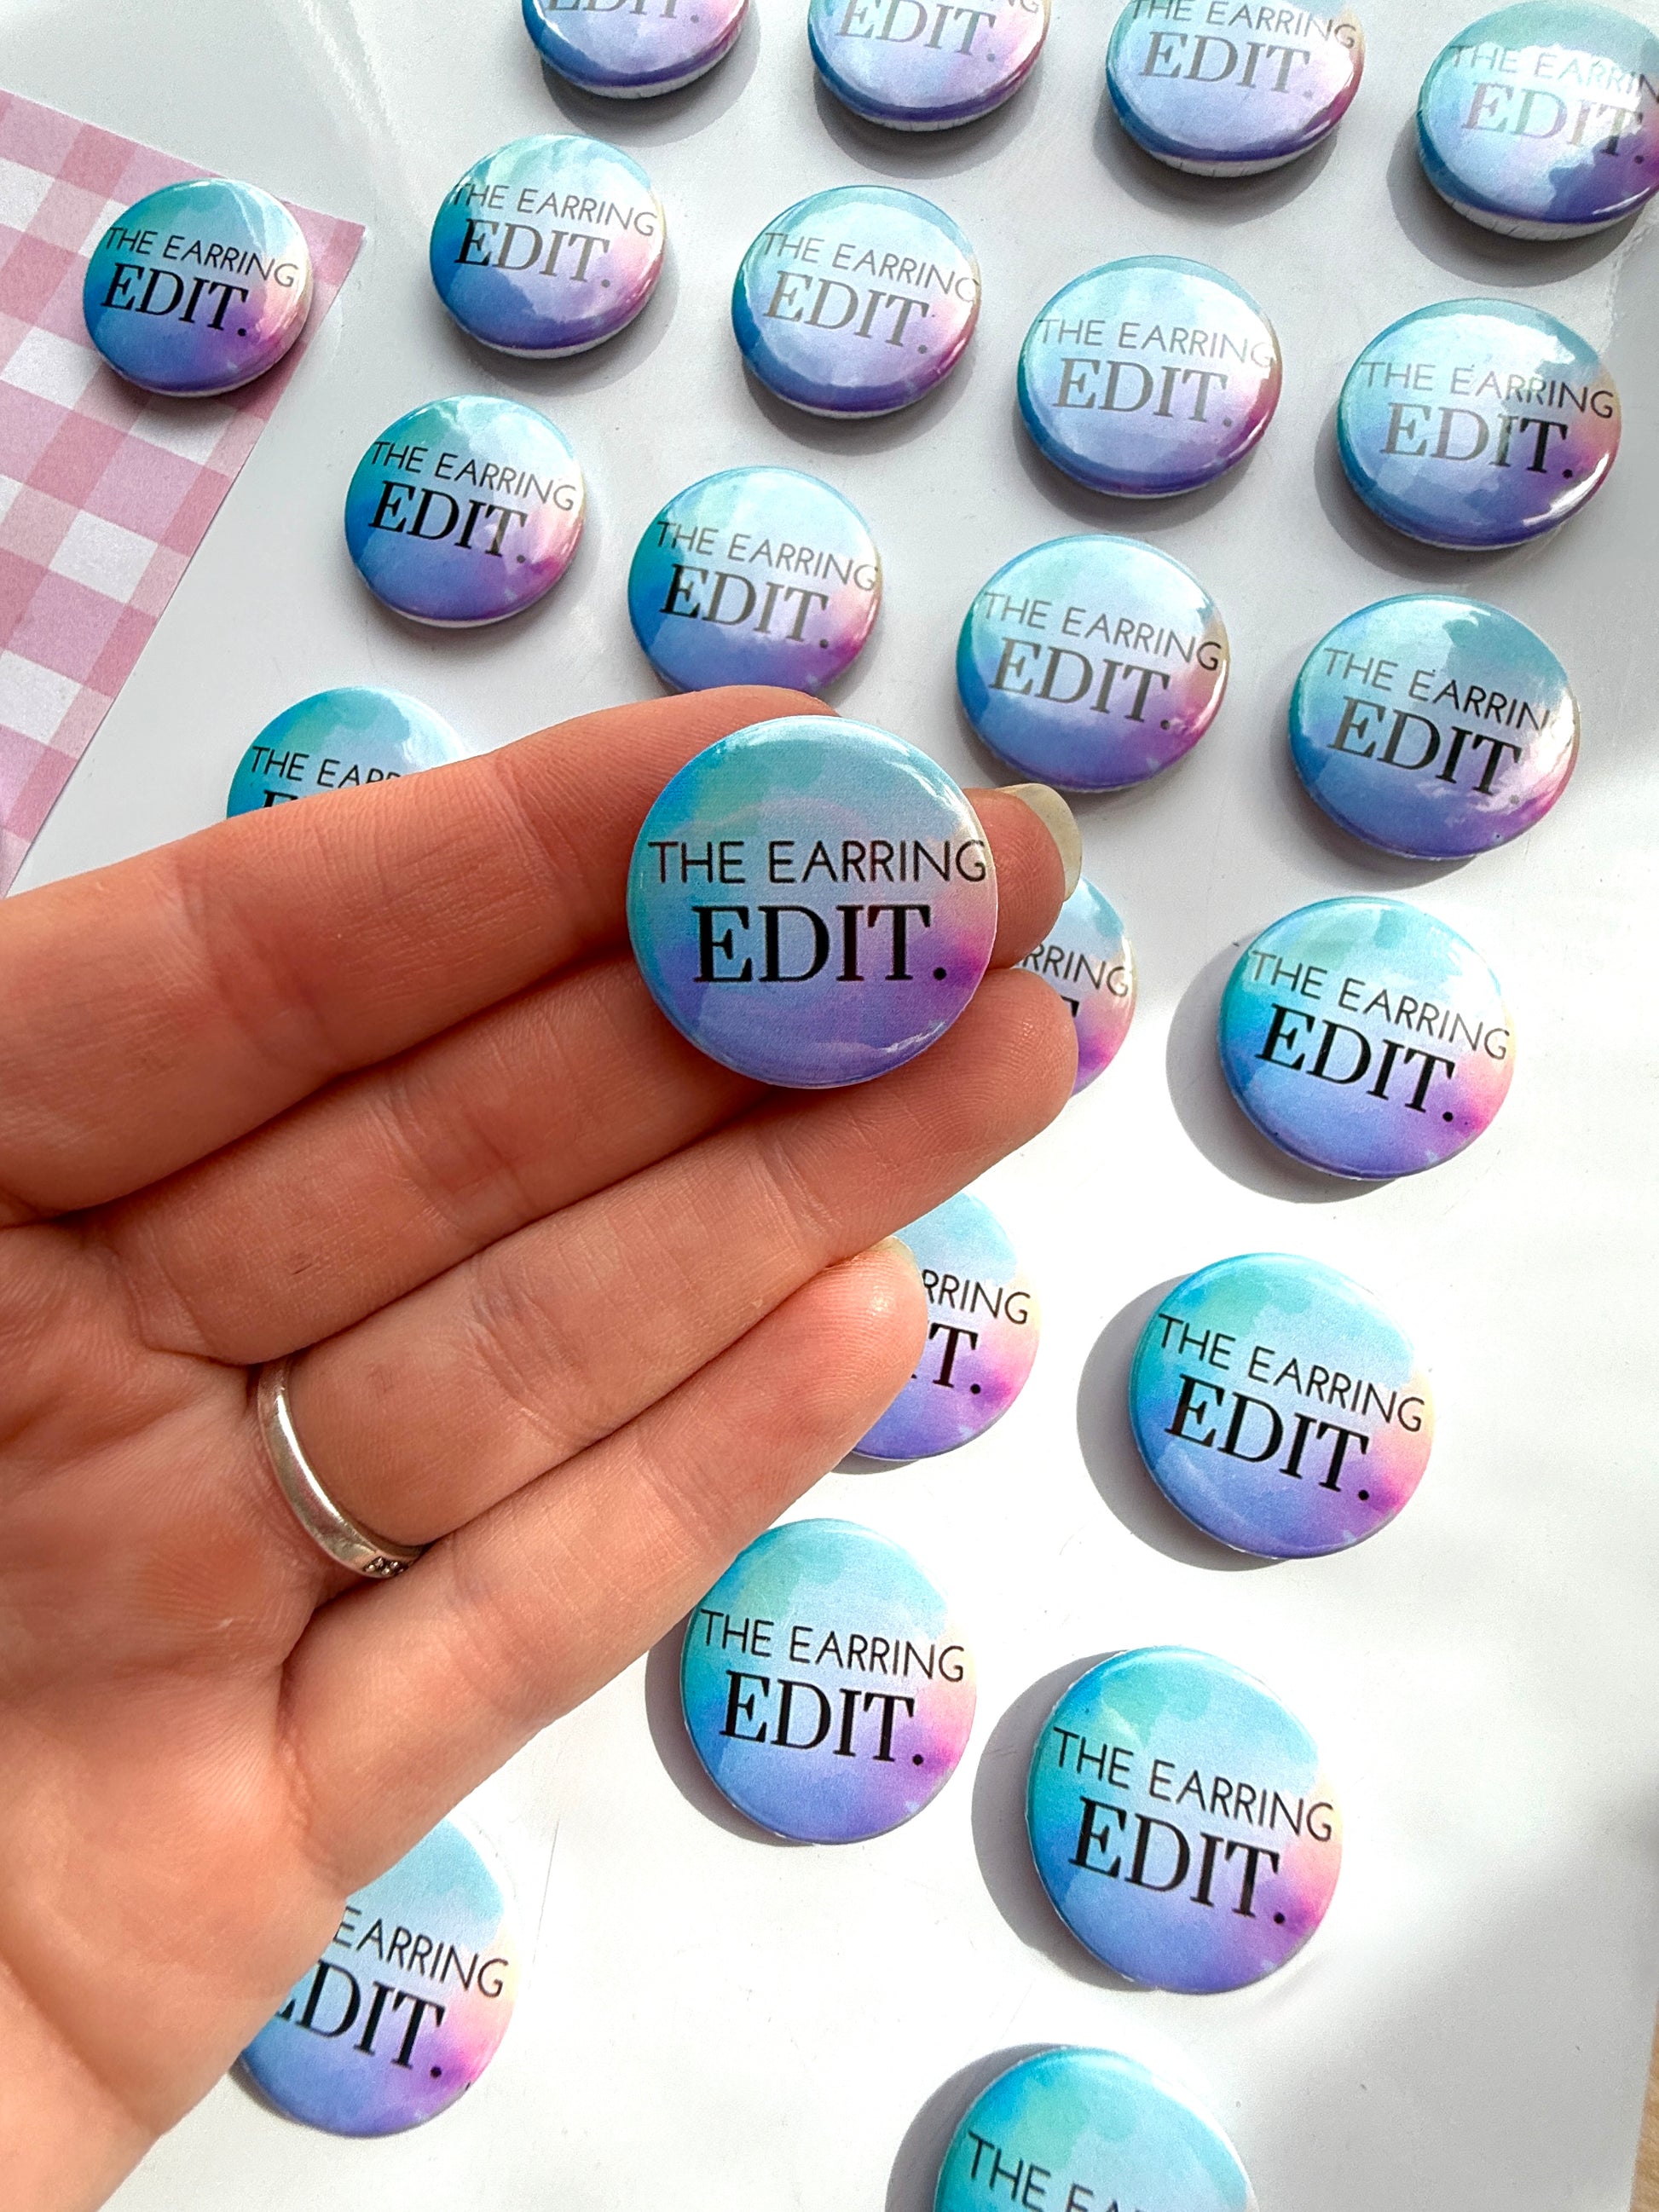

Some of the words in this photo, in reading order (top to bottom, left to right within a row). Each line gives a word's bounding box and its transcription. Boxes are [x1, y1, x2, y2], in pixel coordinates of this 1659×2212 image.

[835, 0, 997, 62] EDIT.
[1206, 1, 1356, 49] EARRING
[1448, 44, 1517, 73] THE
[1139, 31, 1315, 99] EDIT.
[1461, 82, 1645, 165] EDIT.
[453, 182, 504, 213] THE
[517, 188, 657, 237] EARRING
[761, 232, 819, 263] THE
[106, 225, 153, 254] THE
[163, 234, 298, 288] EARRING
[455, 218, 611, 288] EDIT.
[101, 263, 249, 337] EDIT.
[763, 270, 929, 355] EDIT.
[1039, 317, 1106, 347] THE
[1119, 321, 1275, 368] EARRING
[1053, 357, 1232, 427] EDIT.
[1361, 360, 1435, 390] THE
[1449, 361, 1615, 419] EARRING
[370, 441, 428, 474] THE
[436, 453, 576, 512] EARRING
[1380, 401, 1574, 479] EDIT.
[369, 480, 528, 563] EDIT.
[656, 520, 720, 557] THE
[728, 533, 877, 592] EARRING
[660, 563, 830, 649] EDIT.
[984, 591, 1052, 630] THE
[1062, 607, 1221, 672] EARRING
[990, 636, 1171, 731] EDIT.
[1324, 647, 1399, 691] THE
[1408, 668, 1551, 731] EARRIN
[252, 746, 309, 782] THE
[316, 759, 402, 788] EAR
[1327, 696, 1523, 805] EDIT.
[647, 840, 745, 884] THE
[768, 840, 987, 884] EARRING
[692, 904, 948, 983] EDIT.
[1016, 944, 1130, 997] RRING
[1251, 950, 1328, 1000] THE
[1338, 977, 1510, 1060] EARRING
[1255, 1002, 1455, 1123] EDIT.
[922, 1268, 1031, 1325] RRING
[1159, 1313, 1236, 1370] THE
[1248, 1346, 1425, 1432] EARRING
[1165, 1373, 1370, 1501] EDIT.
[701, 1608, 774, 1657] THE
[789, 1626, 964, 1683] EARRING
[720, 1669, 923, 1765] EDIT.
[1054, 1727, 1134, 1790] THE
[1149, 1759, 1333, 1842] EARRING
[1069, 1796, 1285, 1924] EDIT.
[332, 1905, 509, 1998] EARRING
[273, 1959, 446, 2077] DIT.
[968, 2131, 1051, 2212] THE
